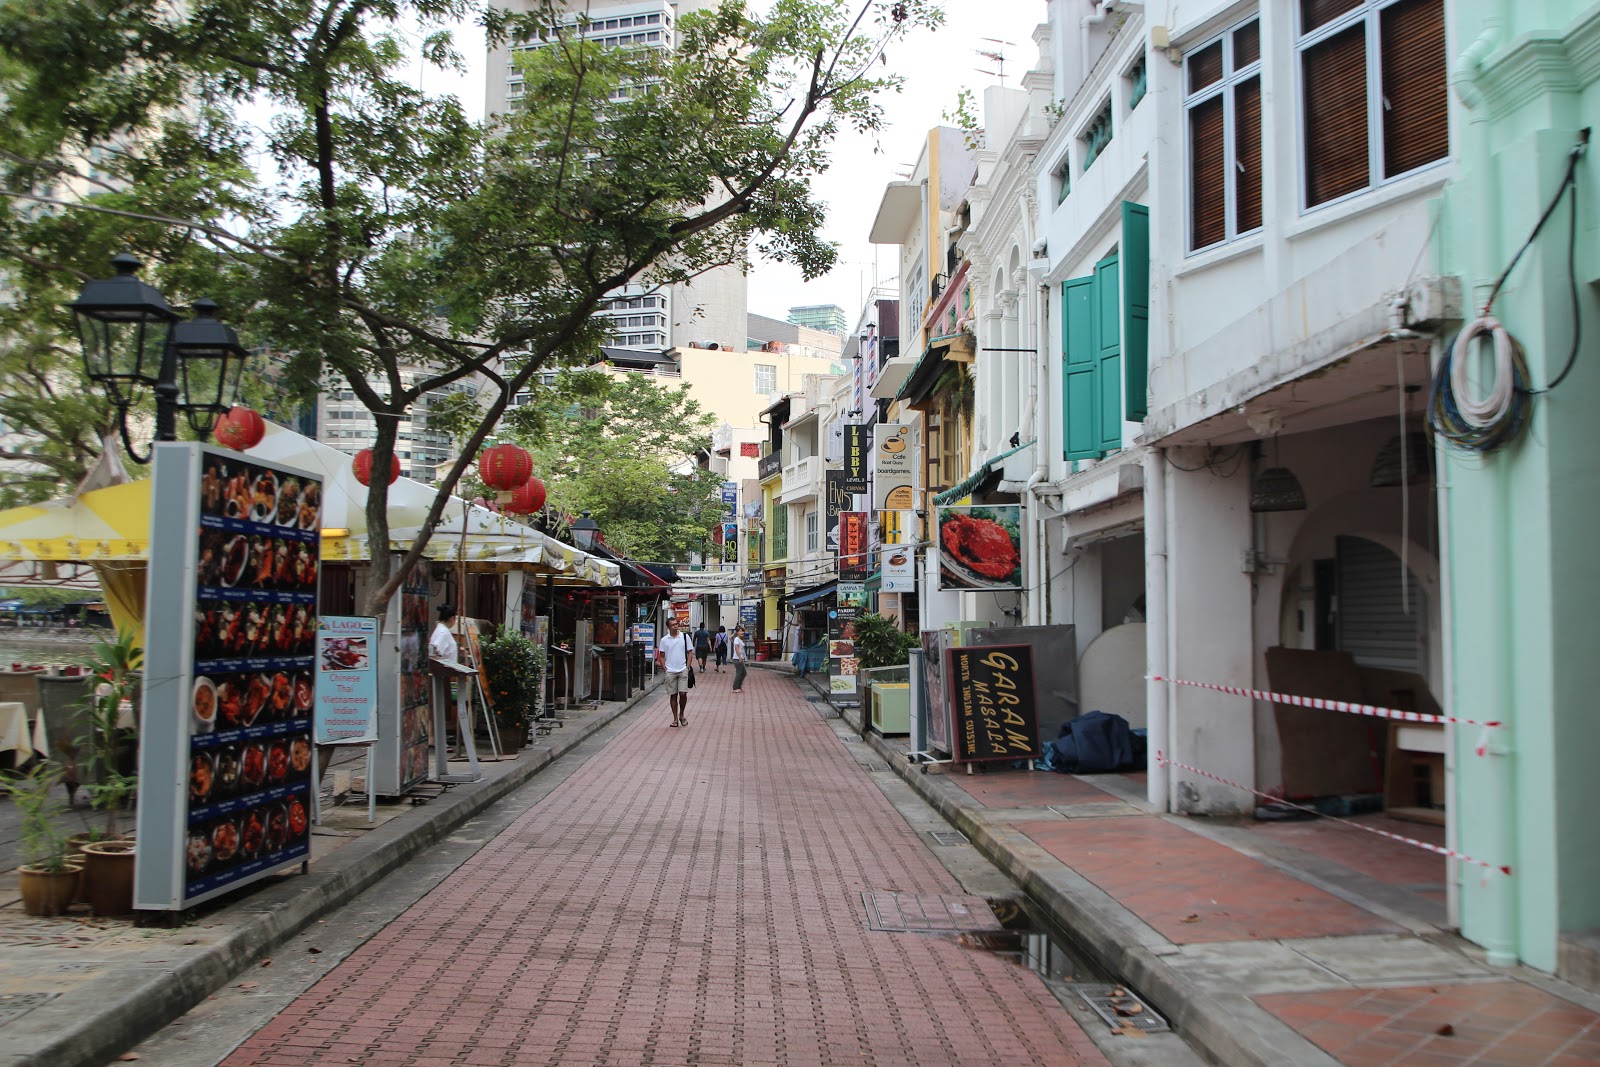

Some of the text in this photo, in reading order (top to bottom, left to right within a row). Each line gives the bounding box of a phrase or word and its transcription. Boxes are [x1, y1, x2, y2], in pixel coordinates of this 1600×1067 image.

[332, 620, 361, 629] LAGO
[960, 654, 970, 681] NORTH
[329, 673, 360, 682] Chinese
[337, 684, 354, 693] Thai
[323, 695, 368, 704] Vietnamese
[963, 686, 973, 716] INDIAN
[979, 651, 1032, 752] GARAM
[333, 706, 358, 715] Indian
[972, 679, 1008, 754] MASALA
[324, 717, 367, 726] Indonesian
